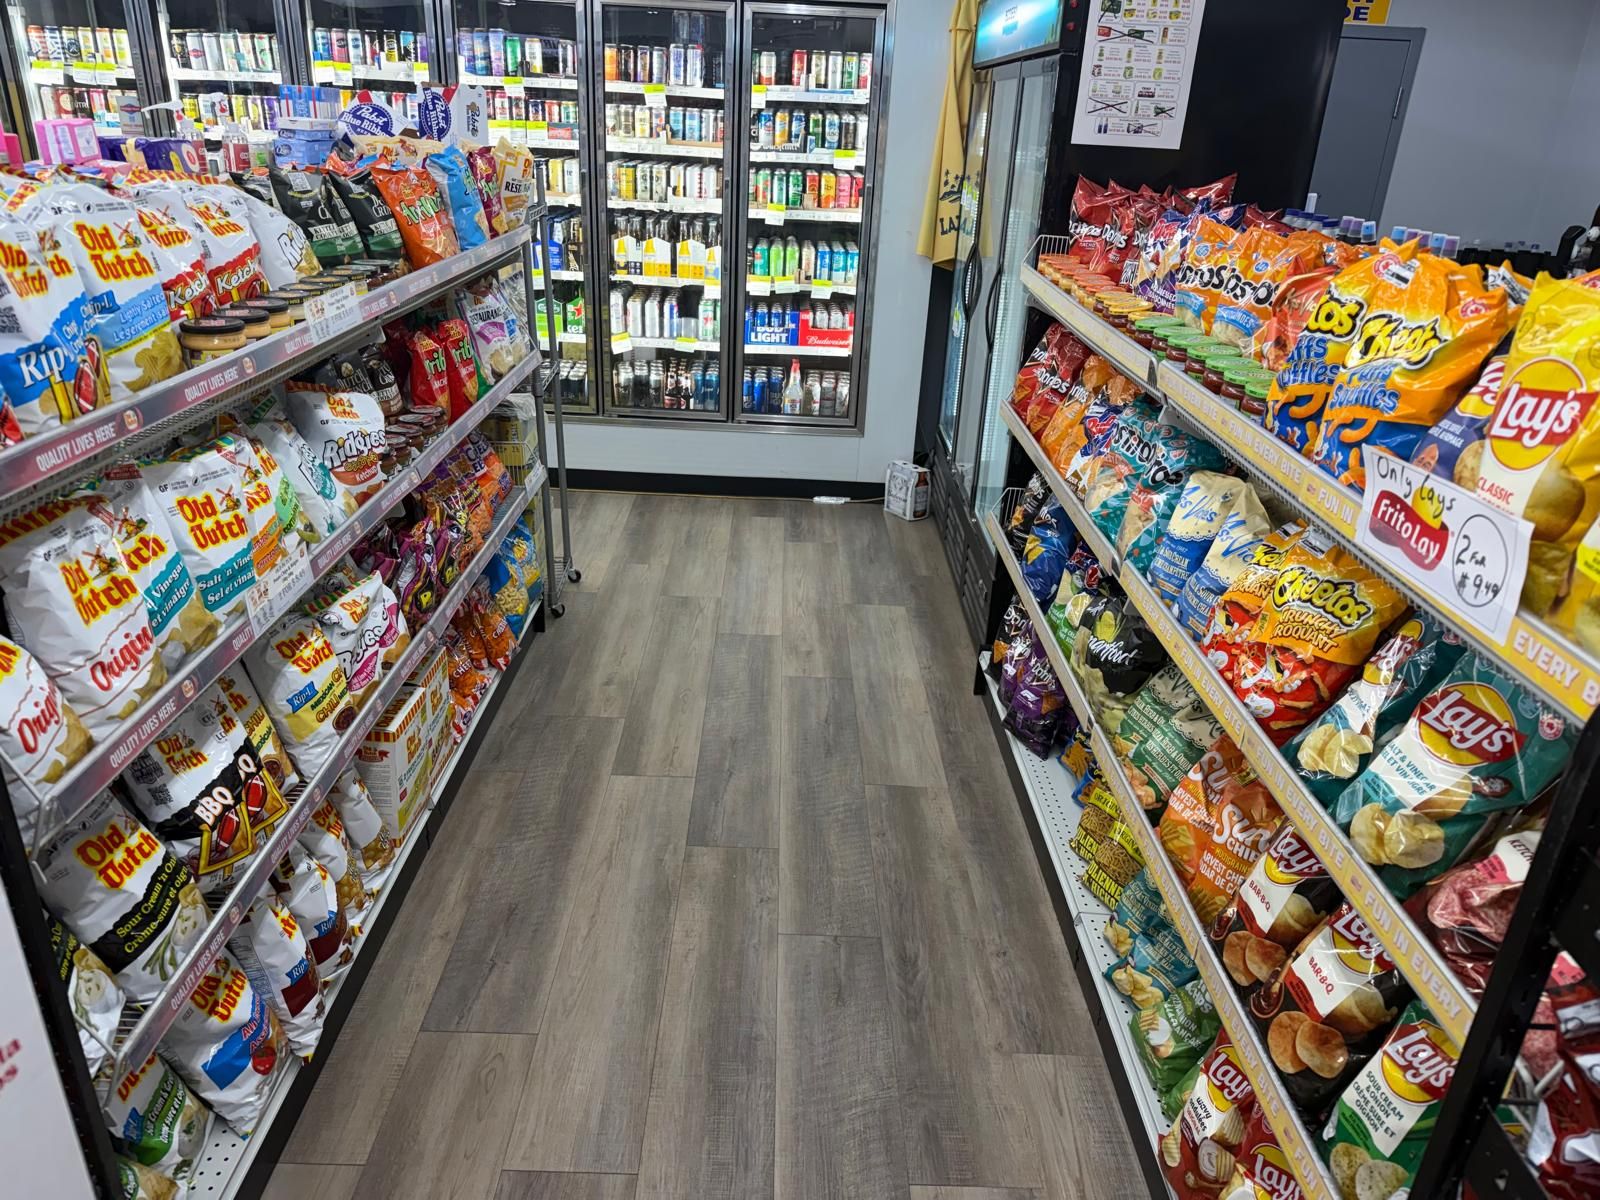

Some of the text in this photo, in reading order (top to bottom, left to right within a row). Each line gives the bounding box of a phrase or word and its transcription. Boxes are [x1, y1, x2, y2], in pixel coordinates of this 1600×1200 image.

[342, 113, 360, 127] Blue
[357, 107, 388, 126] Pabst
[434, 98, 448, 129] Pabst
[74, 222, 118, 251] Old
[7, 268, 49, 299] Dutch
[89, 250, 155, 282] Dutch
[751, 332, 788, 342] LIGHT
[806, 336, 850, 345] Budweiser
[184, 367, 239, 402] QUALITY LIVES HERE
[331, 407, 360, 419] Dutch
[1490, 382, 1581, 448] Lay's
[36, 423, 115, 473] QUALITY LIVES HERE
[322, 429, 386, 471] Ridgies
[159, 484, 168, 493] GF
[1376, 456, 1413, 505] Only
[1478, 476, 1515, 505] CLASSIC
[177, 494, 218, 523] Old
[1317, 489, 1355, 524] FUN IN
[191, 513, 248, 550] Dutch
[1455, 535, 1471, 565] 2
[60, 557, 89, 594] Old
[76, 574, 138, 626] Dutch
[1273, 566, 1373, 630] Cheetos
[1513, 628, 1579, 688] EVERY
[110, 699, 177, 769] QUALITY LIVES HERE
[1421, 690, 1513, 753] Lay's
[194, 786, 235, 826] BBQ
[77, 825, 125, 867] Old
[99, 831, 160, 888] Dutch
[1318, 828, 1345, 867] BITE
[117, 914, 141, 938] Sour
[141, 882, 162, 914] Cream
[170, 930, 226, 1010] QUALITY LIVES HERE
[1364, 891, 1461, 1019] FUN IN EVERY
[1382, 1028, 1457, 1088] Lay's
[1352, 1081, 1373, 1108] CRÈME
[1368, 1103, 1387, 1130] SURE
[1383, 1126, 1396, 1139] ET
[1366, 1070, 1404, 1122] SOUR CREAM
[1355, 1100, 1380, 1133] OIGNON
